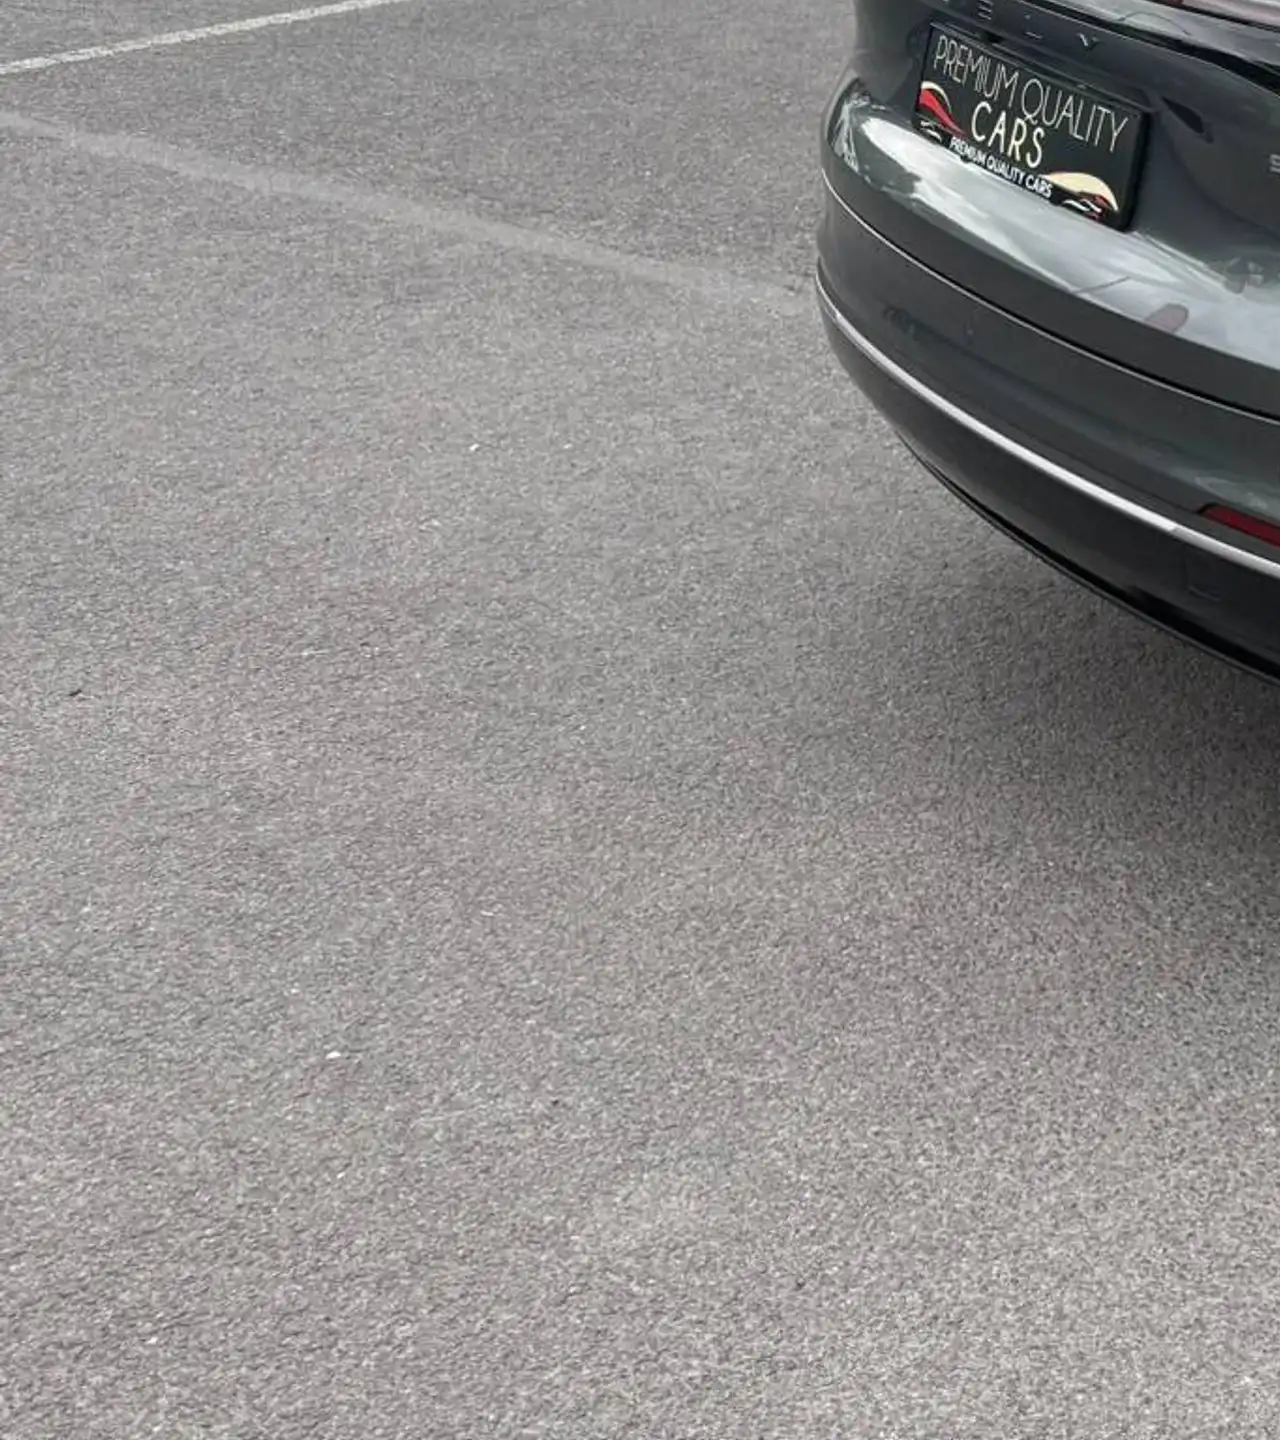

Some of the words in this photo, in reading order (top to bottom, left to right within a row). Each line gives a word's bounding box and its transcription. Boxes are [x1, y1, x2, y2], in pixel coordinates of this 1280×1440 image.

[933, 35, 1019, 108] PREMIUM
[1020, 78, 1129, 153] QUALITY
[971, 101, 1045, 168] CARS
[987, 155, 1025, 184] QUALITY
[1025, 174, 1053, 198] CARS
